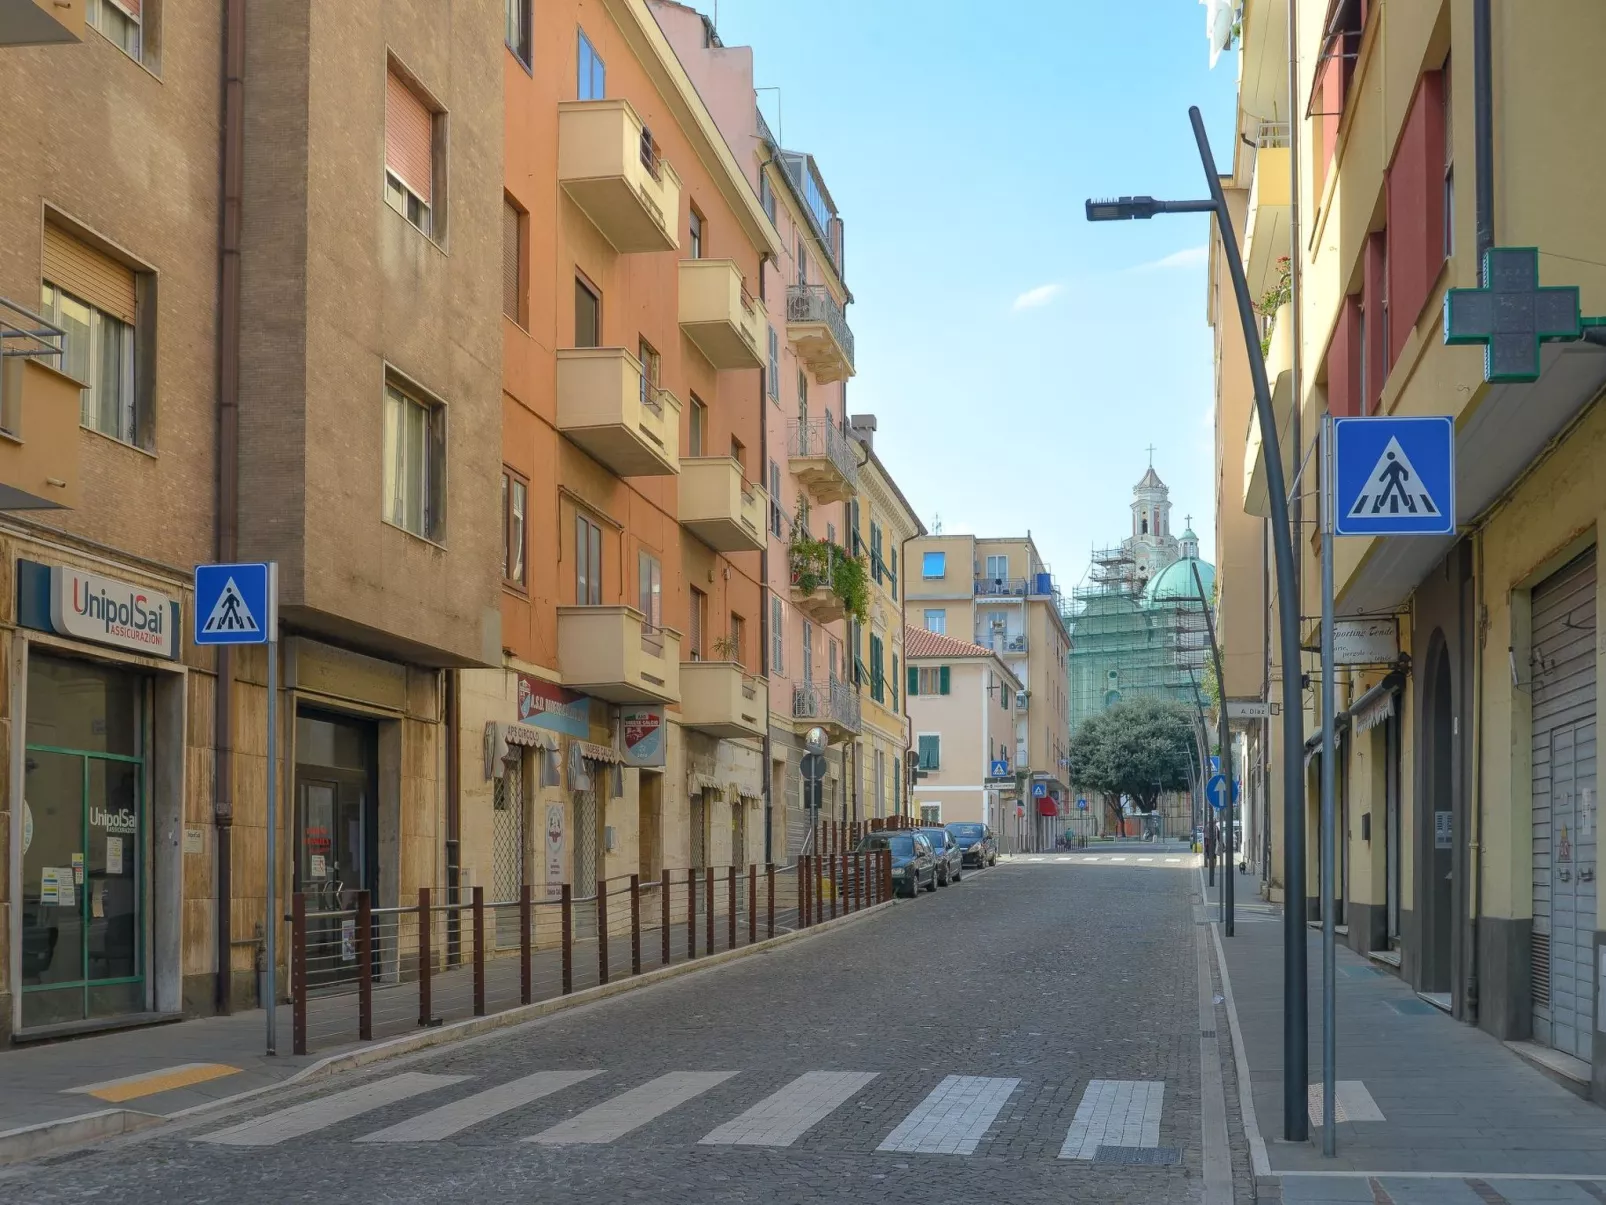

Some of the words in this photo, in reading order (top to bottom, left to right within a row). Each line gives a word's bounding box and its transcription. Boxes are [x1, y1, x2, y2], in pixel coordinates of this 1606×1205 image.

[73, 577, 162, 634] UnipolSai
[110, 625, 163, 646] ASSICURAZIONI
[90, 806, 137, 833] UnipolSai
